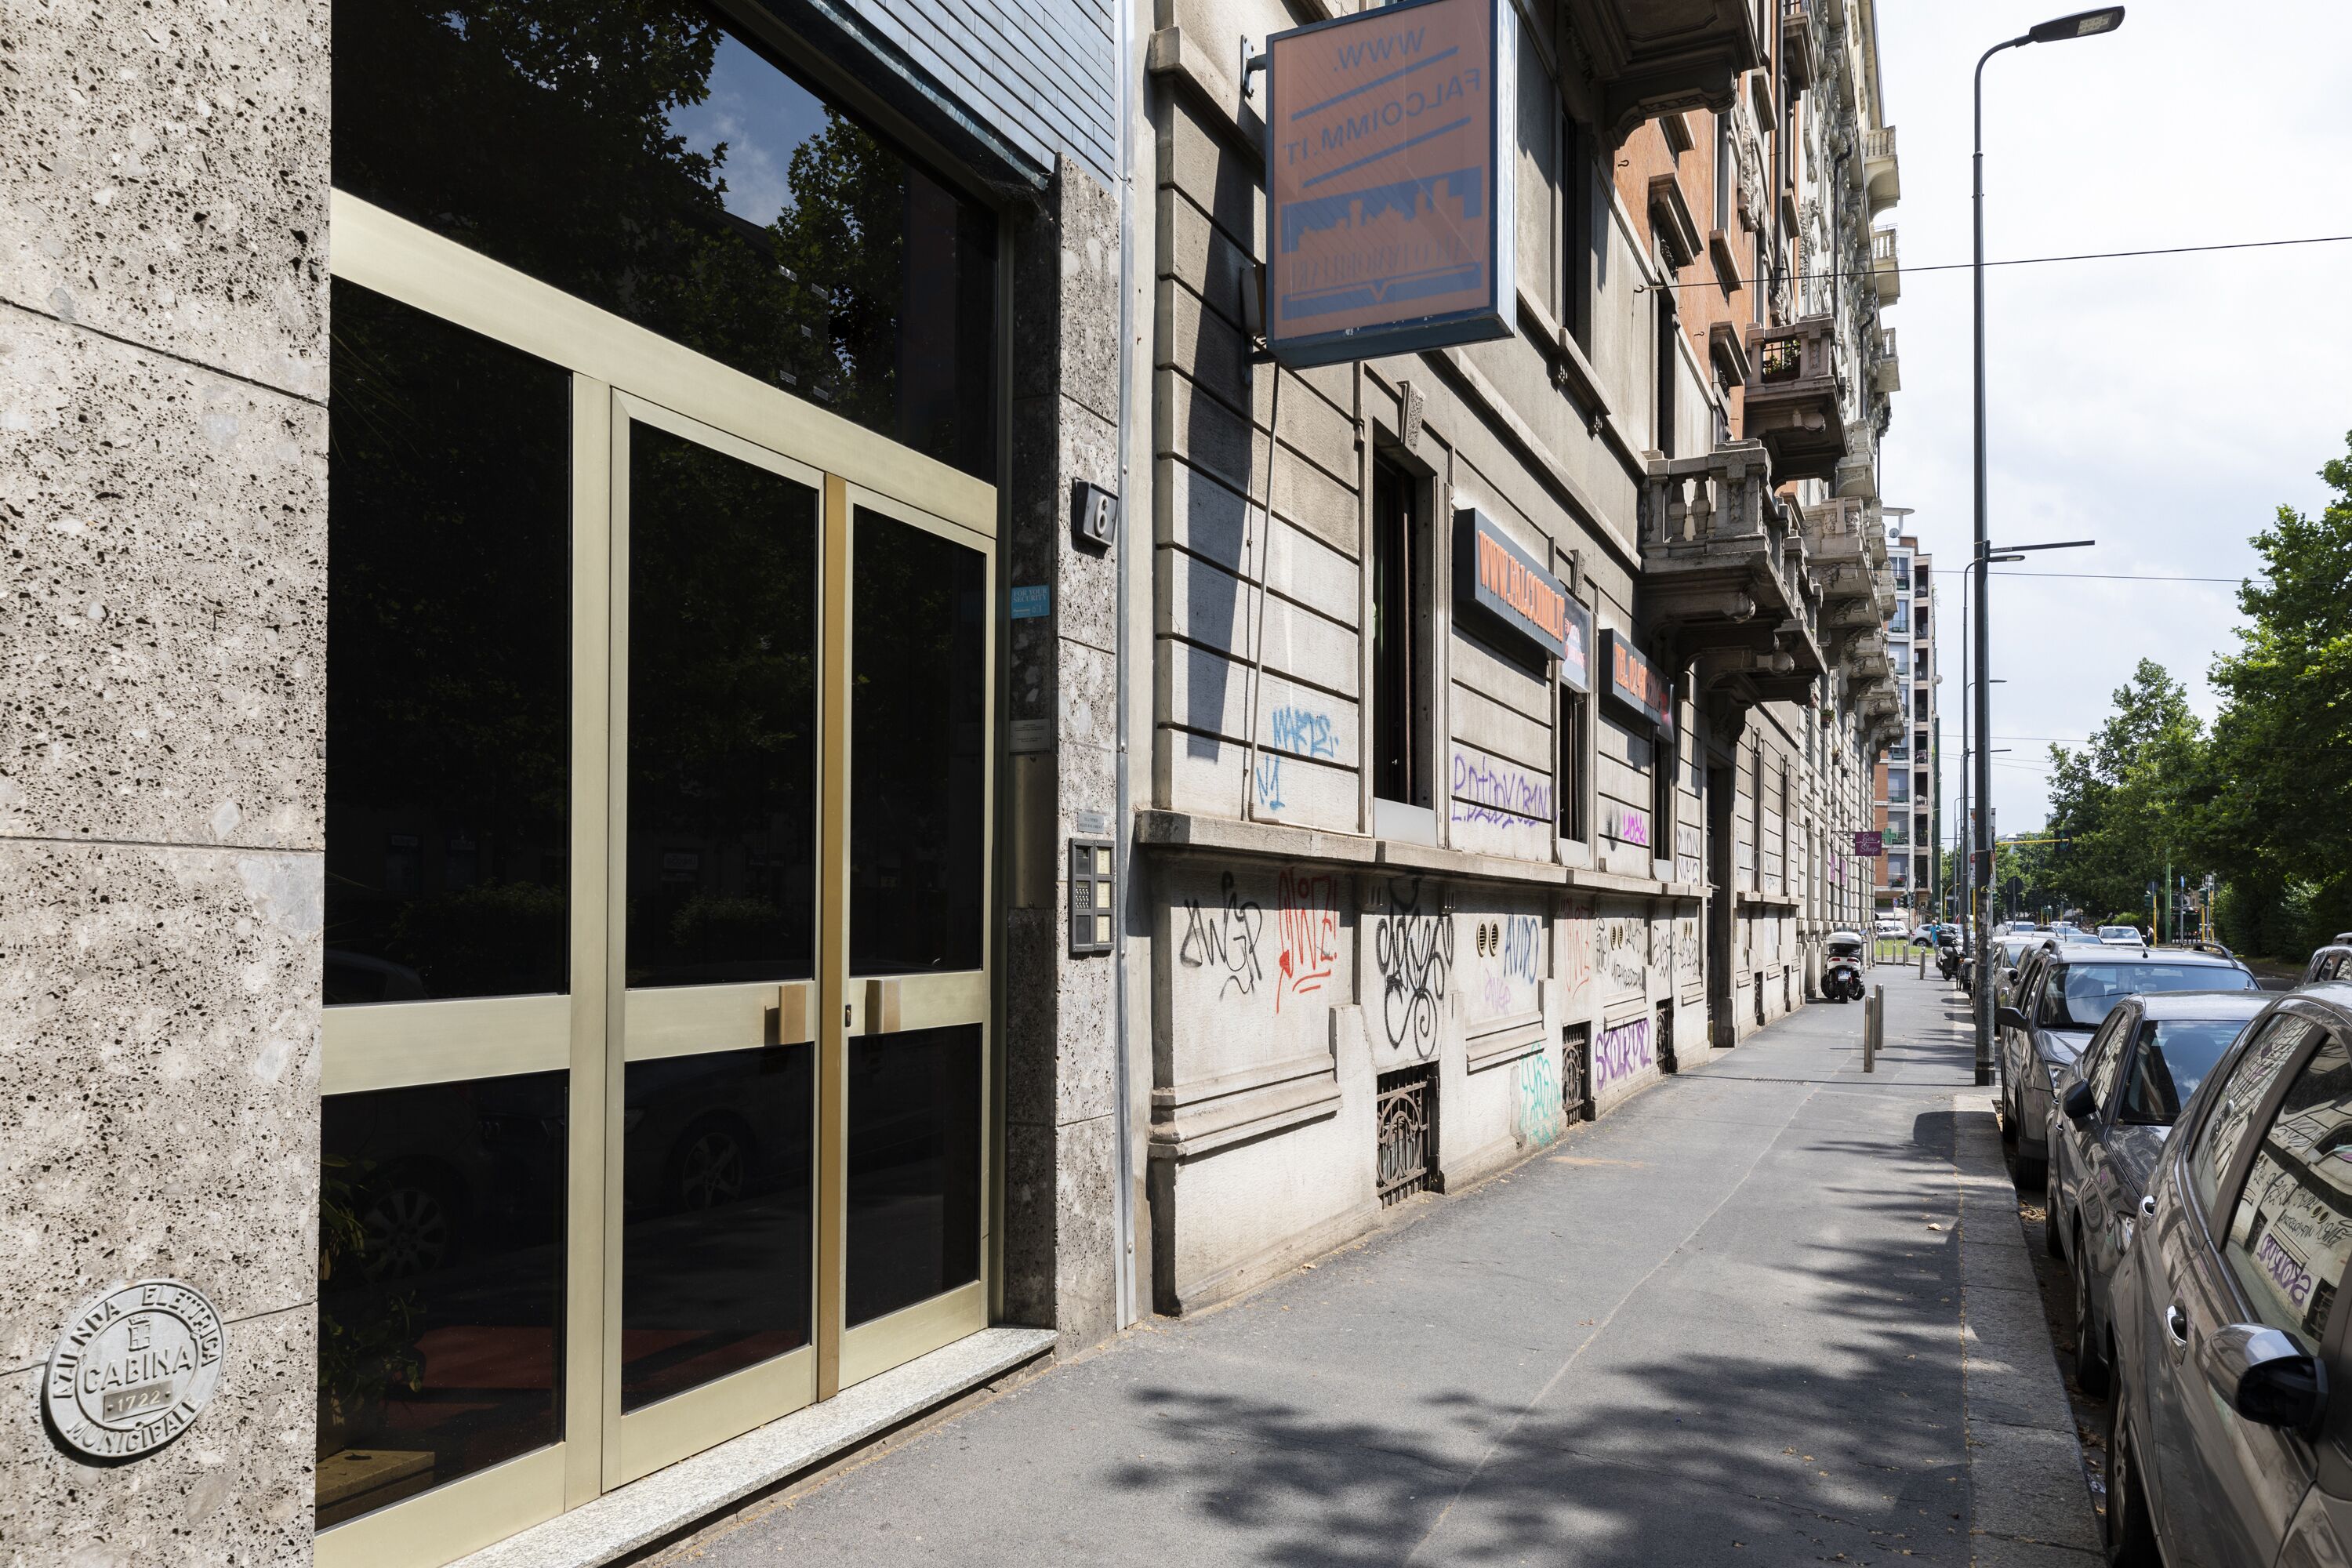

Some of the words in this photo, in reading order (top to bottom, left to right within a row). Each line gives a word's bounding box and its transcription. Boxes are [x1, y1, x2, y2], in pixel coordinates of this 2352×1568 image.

[1095, 495, 1108, 535] 6
[1860, 844, 1878, 855] Shop
[1862, 833, 1876, 845] Sex
[53, 1300, 122, 1399] AZIENDA
[141, 1284, 221, 1368] ELETTRICA
[84, 1345, 193, 1395] CABINA
[118, 1389, 161, 1413] 1722
[66, 1392, 202, 1454] MUNICIPALE
